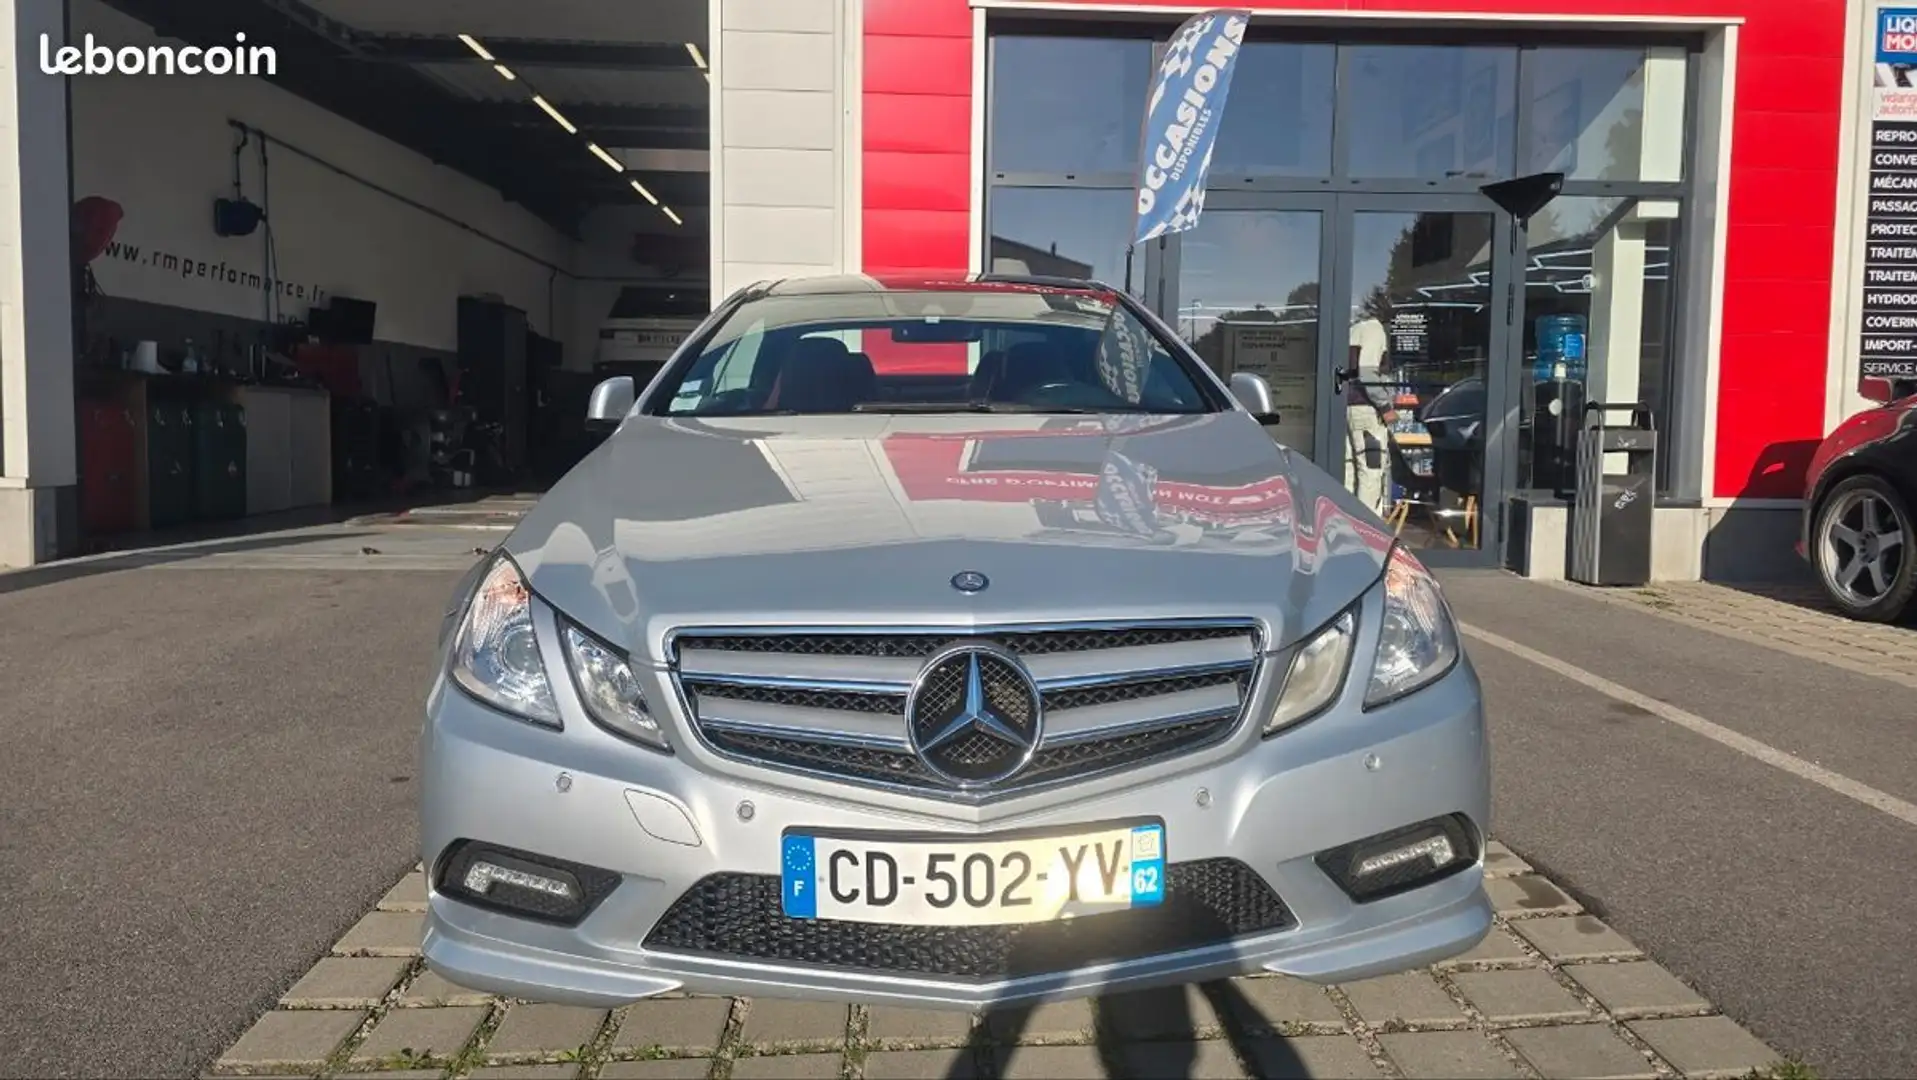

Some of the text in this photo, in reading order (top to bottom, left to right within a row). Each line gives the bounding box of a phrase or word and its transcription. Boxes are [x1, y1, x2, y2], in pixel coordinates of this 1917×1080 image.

[1885, 34, 1917, 51] MO
[1886, 16, 1917, 34] LIQ
[1138, 16, 1246, 215] OCCASIONS
[1171, 108, 1212, 181] DISPONIBLES
[1863, 362, 1913, 374] SERVICE
[793, 839, 1158, 909] F CD-502-YV 62
